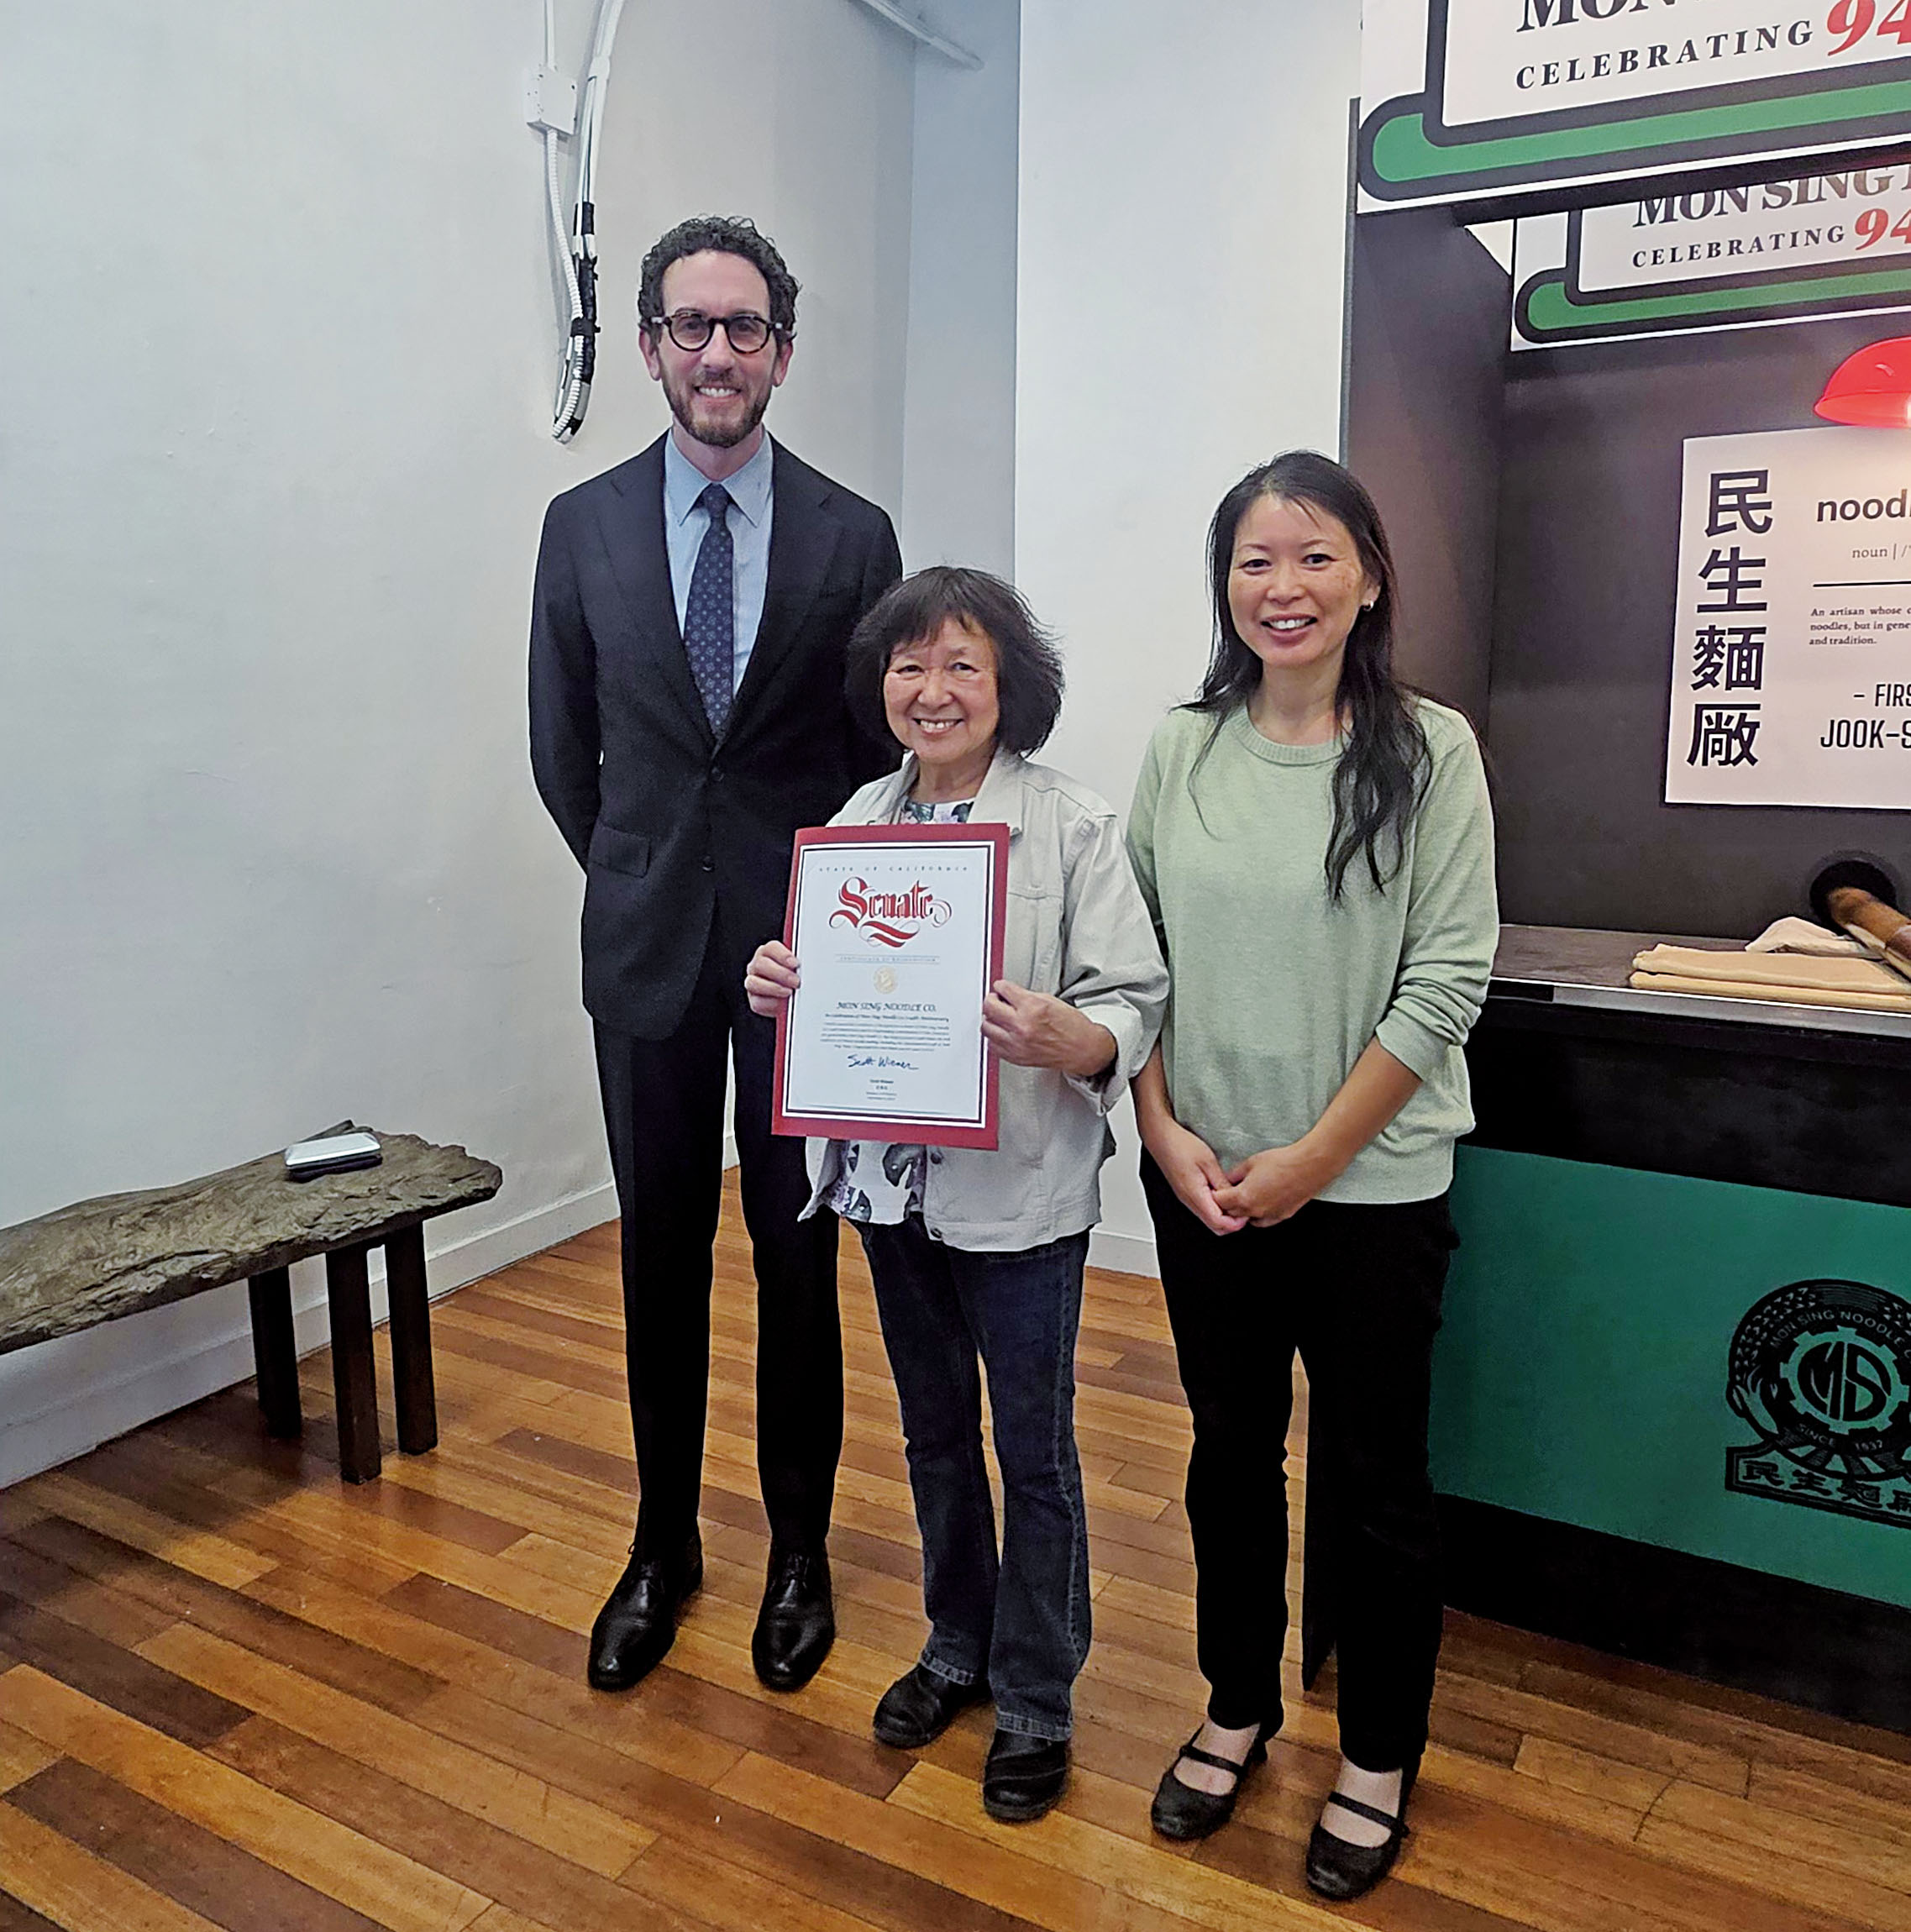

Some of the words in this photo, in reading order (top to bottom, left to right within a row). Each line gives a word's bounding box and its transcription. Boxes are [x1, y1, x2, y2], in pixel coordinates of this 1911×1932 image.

[1516, 20, 1814, 90] CELEBRATING
[1827, 0, 1911, 56] 94
[1632, 186, 1749, 228] MON
[1761, 168, 1895, 210] SING
[1632, 225, 1845, 268] CELEBRATING
[1817, 488, 1911, 522] nood
[1851, 549, 1887, 558] noun
[1810, 608, 1825, 617] An
[1830, 607, 1865, 616] artisan
[1870, 606, 1902, 615] whose
[1810, 622, 1851, 631] noodles,
[1854, 622, 1871, 630] but
[1873, 622, 1883, 630] in
[1809, 636, 1828, 645] and
[1830, 636, 1877, 645] tradition.
[829, 876, 941, 939] Senate
[1797, 1310, 1835, 1325] SING
[1840, 1310, 1904, 1345] NOODLE
